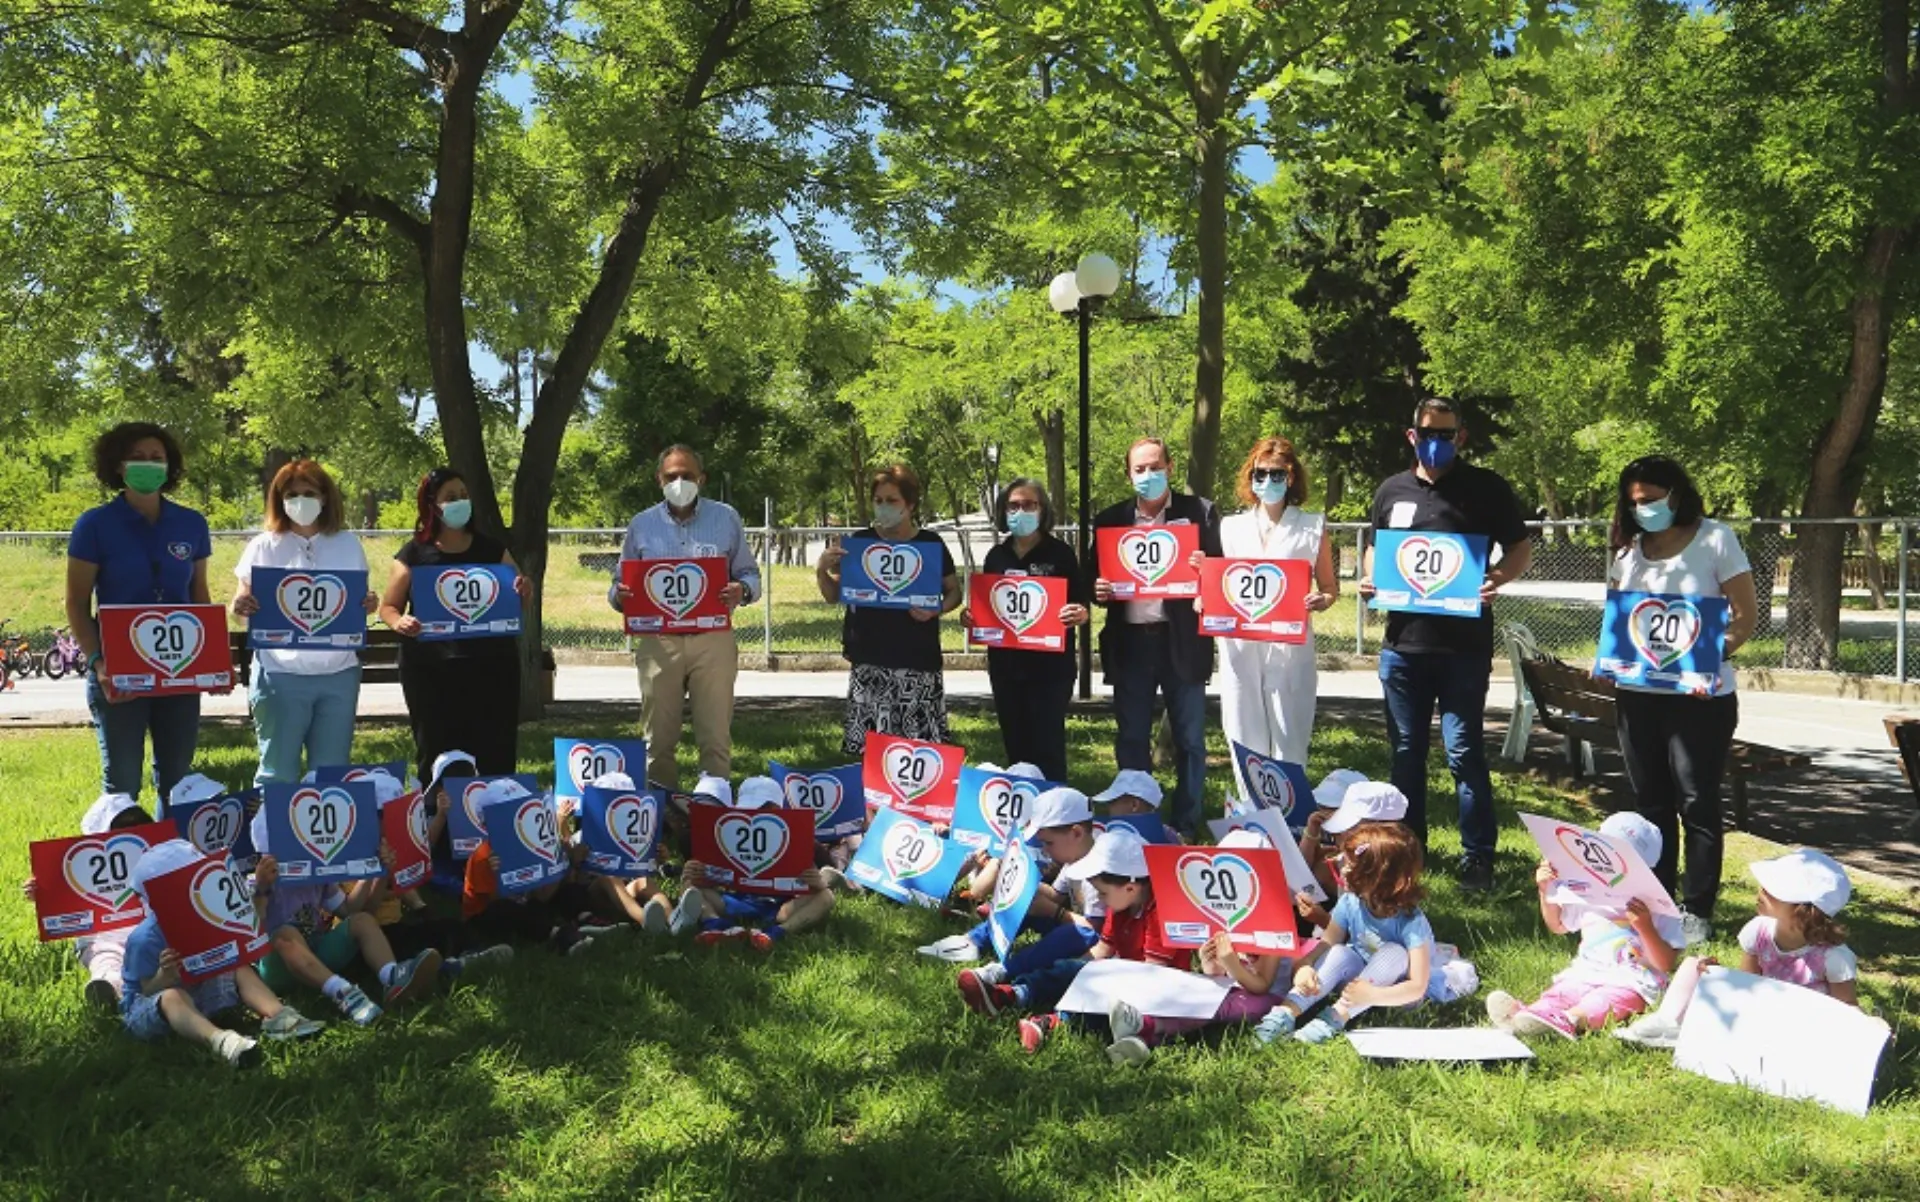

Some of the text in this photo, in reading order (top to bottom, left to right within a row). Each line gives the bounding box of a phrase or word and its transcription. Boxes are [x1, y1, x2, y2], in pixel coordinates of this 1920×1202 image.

[880, 554, 904, 575] 20
[1136, 541, 1160, 564] 20
[1415, 550, 1442, 575] 20
[297, 587, 327, 611] 20
[454, 579, 481, 603] 20
[663, 574, 689, 598] 20
[1241, 576, 1266, 599] 20
[1006, 591, 1030, 613] 30
[153, 625, 183, 652] 20
[1649, 614, 1680, 643] 20
[581, 756, 606, 778] 20
[898, 756, 925, 781] 20
[798, 786, 824, 807] 20
[1259, 770, 1281, 799] 20
[997, 792, 1022, 818] 20
[205, 814, 229, 842] 20
[308, 803, 337, 835] 20
[535, 811, 556, 840] 20
[626, 810, 649, 836] 20
[736, 827, 766, 853] 20
[896, 835, 924, 862] 20
[1574, 839, 1612, 865] 20
[90, 851, 128, 884] 20
[219, 870, 249, 909] 20
[1201, 869, 1237, 900] 20
